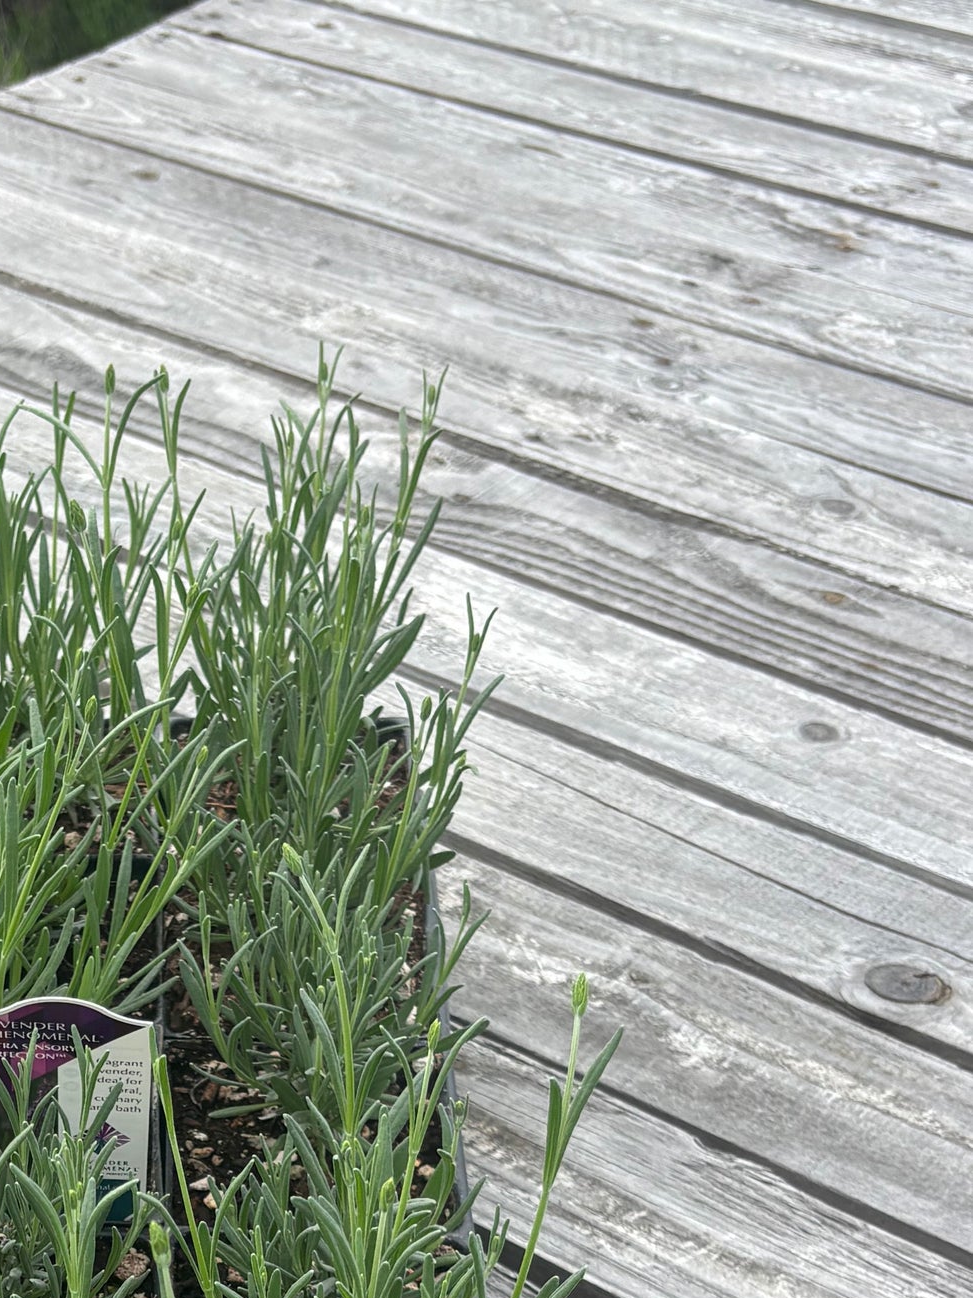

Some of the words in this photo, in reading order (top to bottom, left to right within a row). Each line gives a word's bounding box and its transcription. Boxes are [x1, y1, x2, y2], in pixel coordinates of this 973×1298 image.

[22, 1043, 76, 1053] SNSORY
[126, 1077, 142, 1085] for
[115, 1105, 141, 1113] bath
